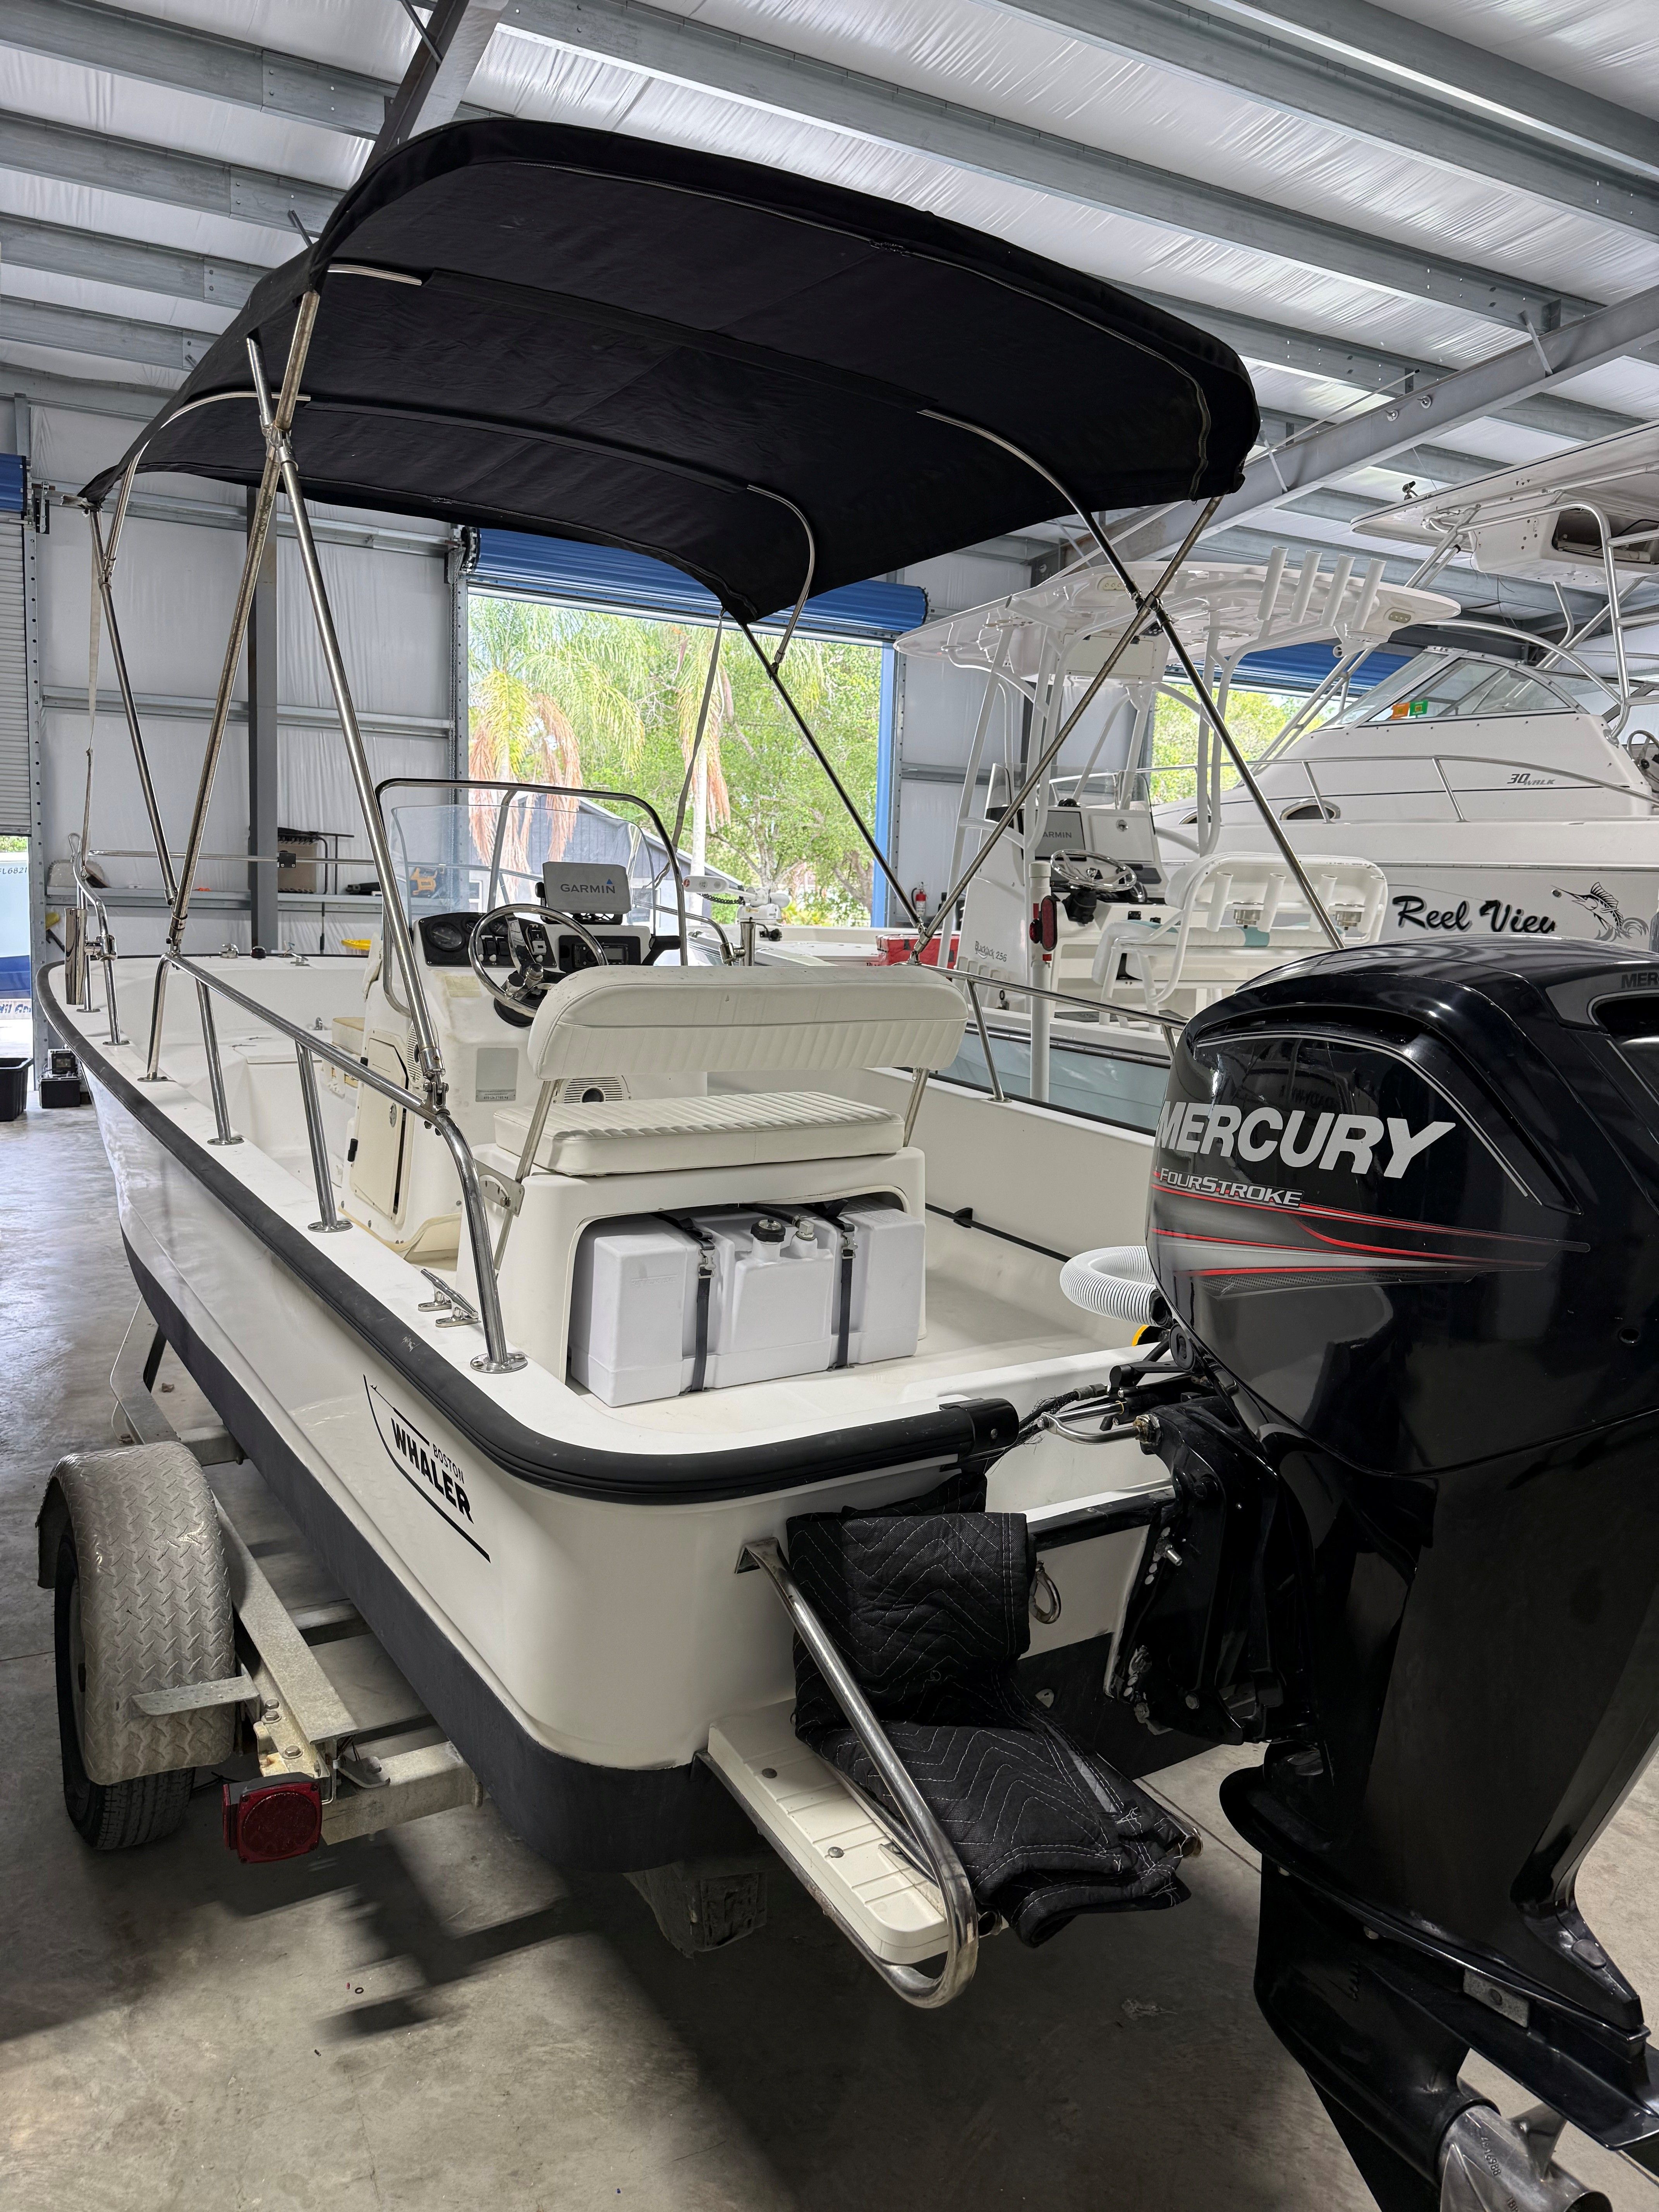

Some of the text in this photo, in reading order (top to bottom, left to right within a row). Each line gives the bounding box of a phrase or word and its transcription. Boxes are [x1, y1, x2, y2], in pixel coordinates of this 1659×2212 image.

[1507, 773, 1530, 784] 30
[560, 884, 616, 894] GARMIN
[1392, 895, 1472, 932] Reel
[996, 951, 1007, 962] 256
[1156, 1101, 1456, 1178] MERCURY
[391, 1417, 474, 1525] WHALER
[433, 1443, 465, 1484] BOSTON
